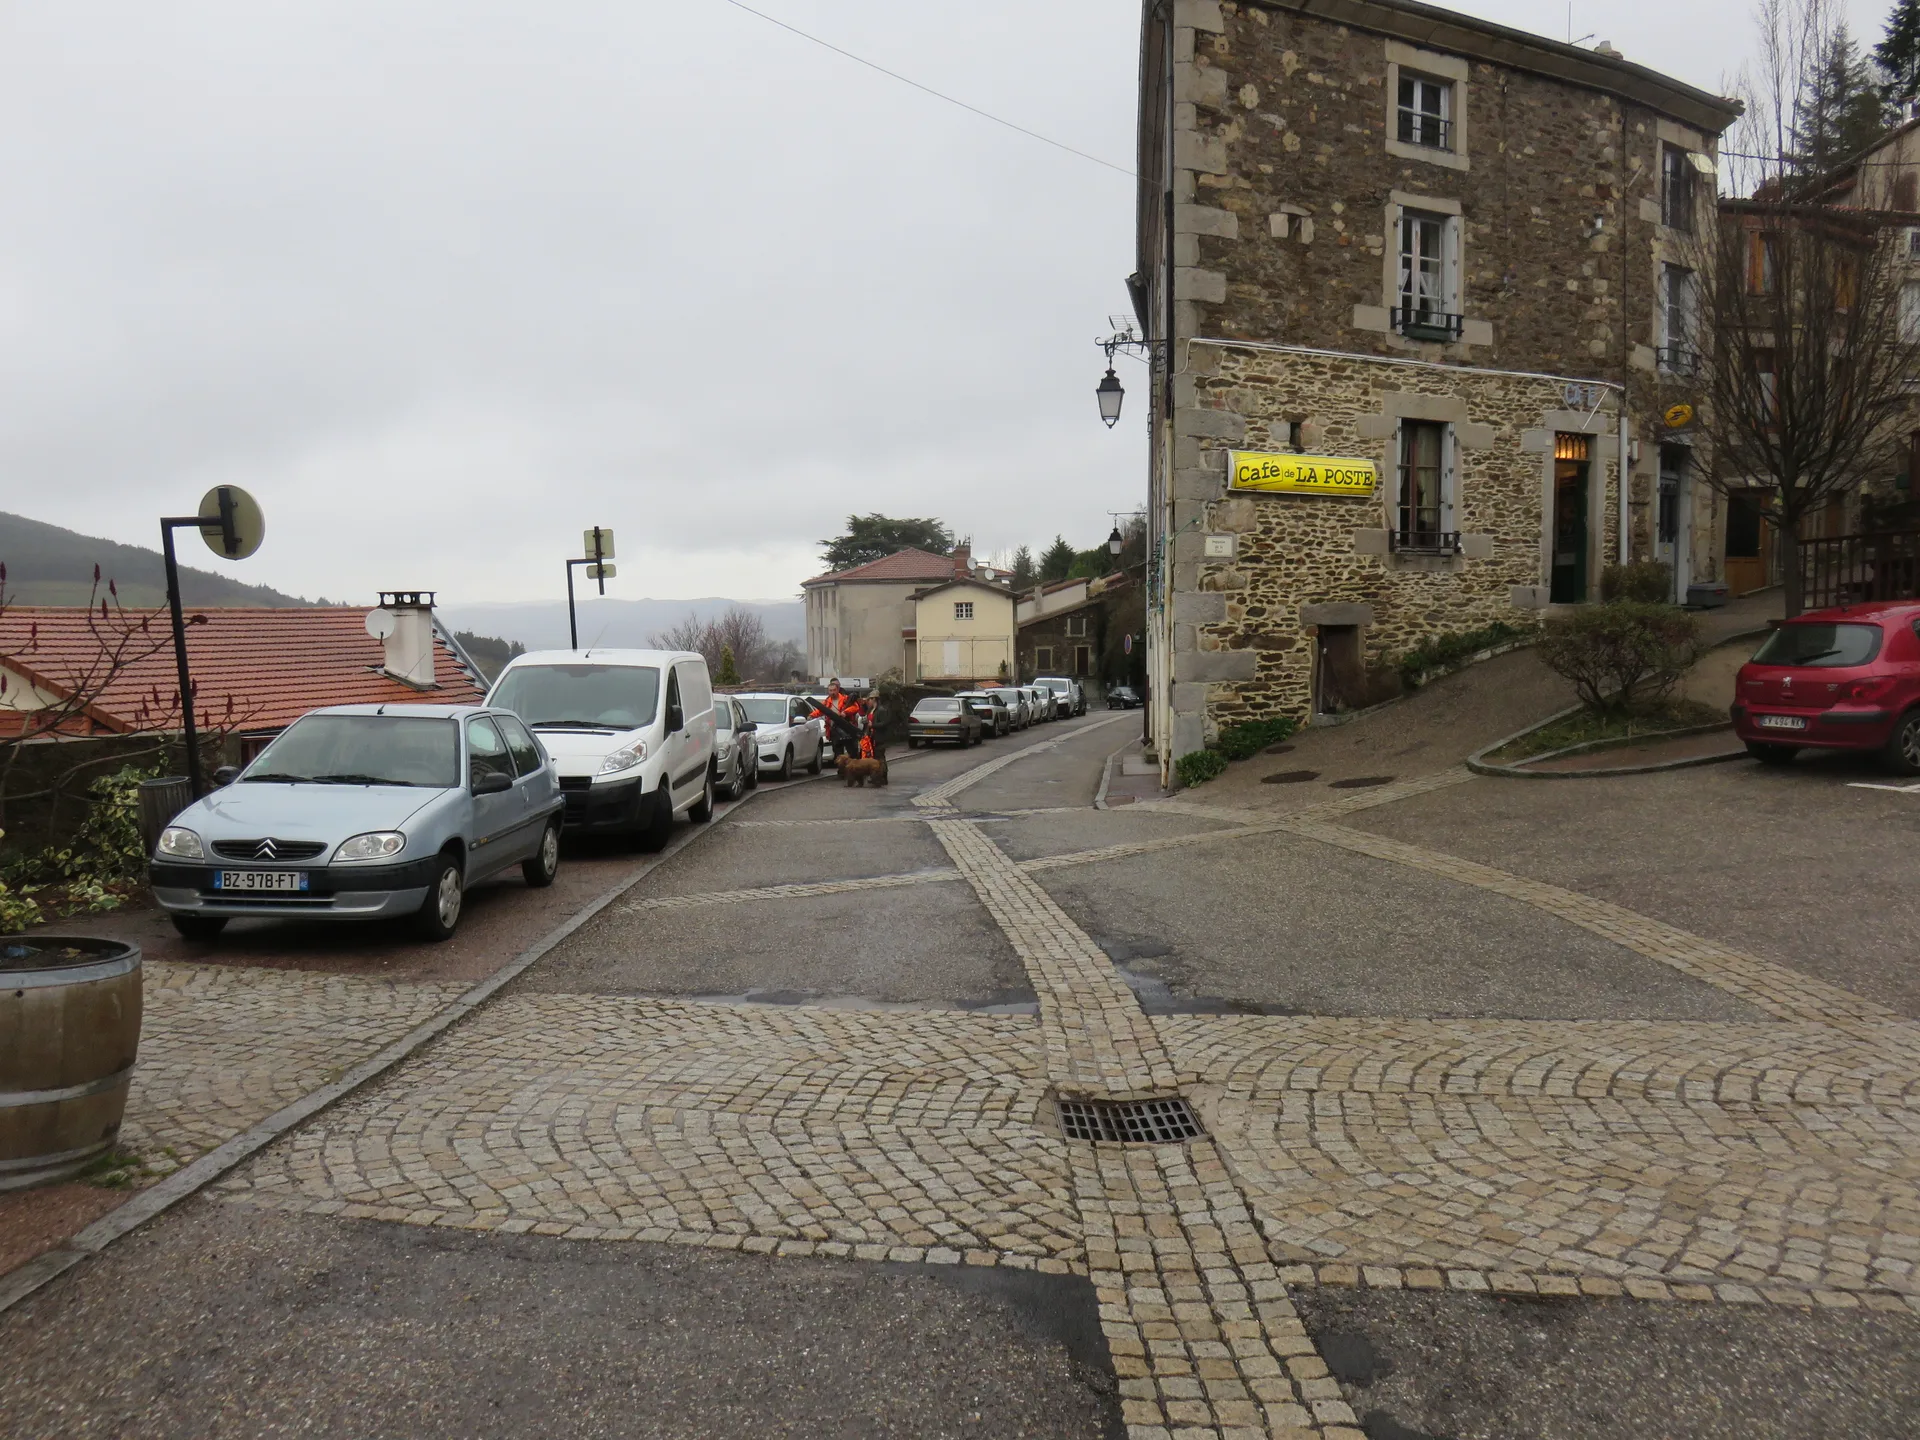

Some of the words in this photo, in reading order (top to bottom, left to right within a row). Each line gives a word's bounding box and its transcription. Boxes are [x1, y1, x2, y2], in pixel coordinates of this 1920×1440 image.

[1564, 383, 1598, 407] CAE
[1239, 460, 1281, 482] Café
[1284, 469, 1295, 478] de
[1295, 467, 1318, 483] LA
[1324, 469, 1373, 486] POSTE
[223, 873, 296, 889] BZ-978-FT
